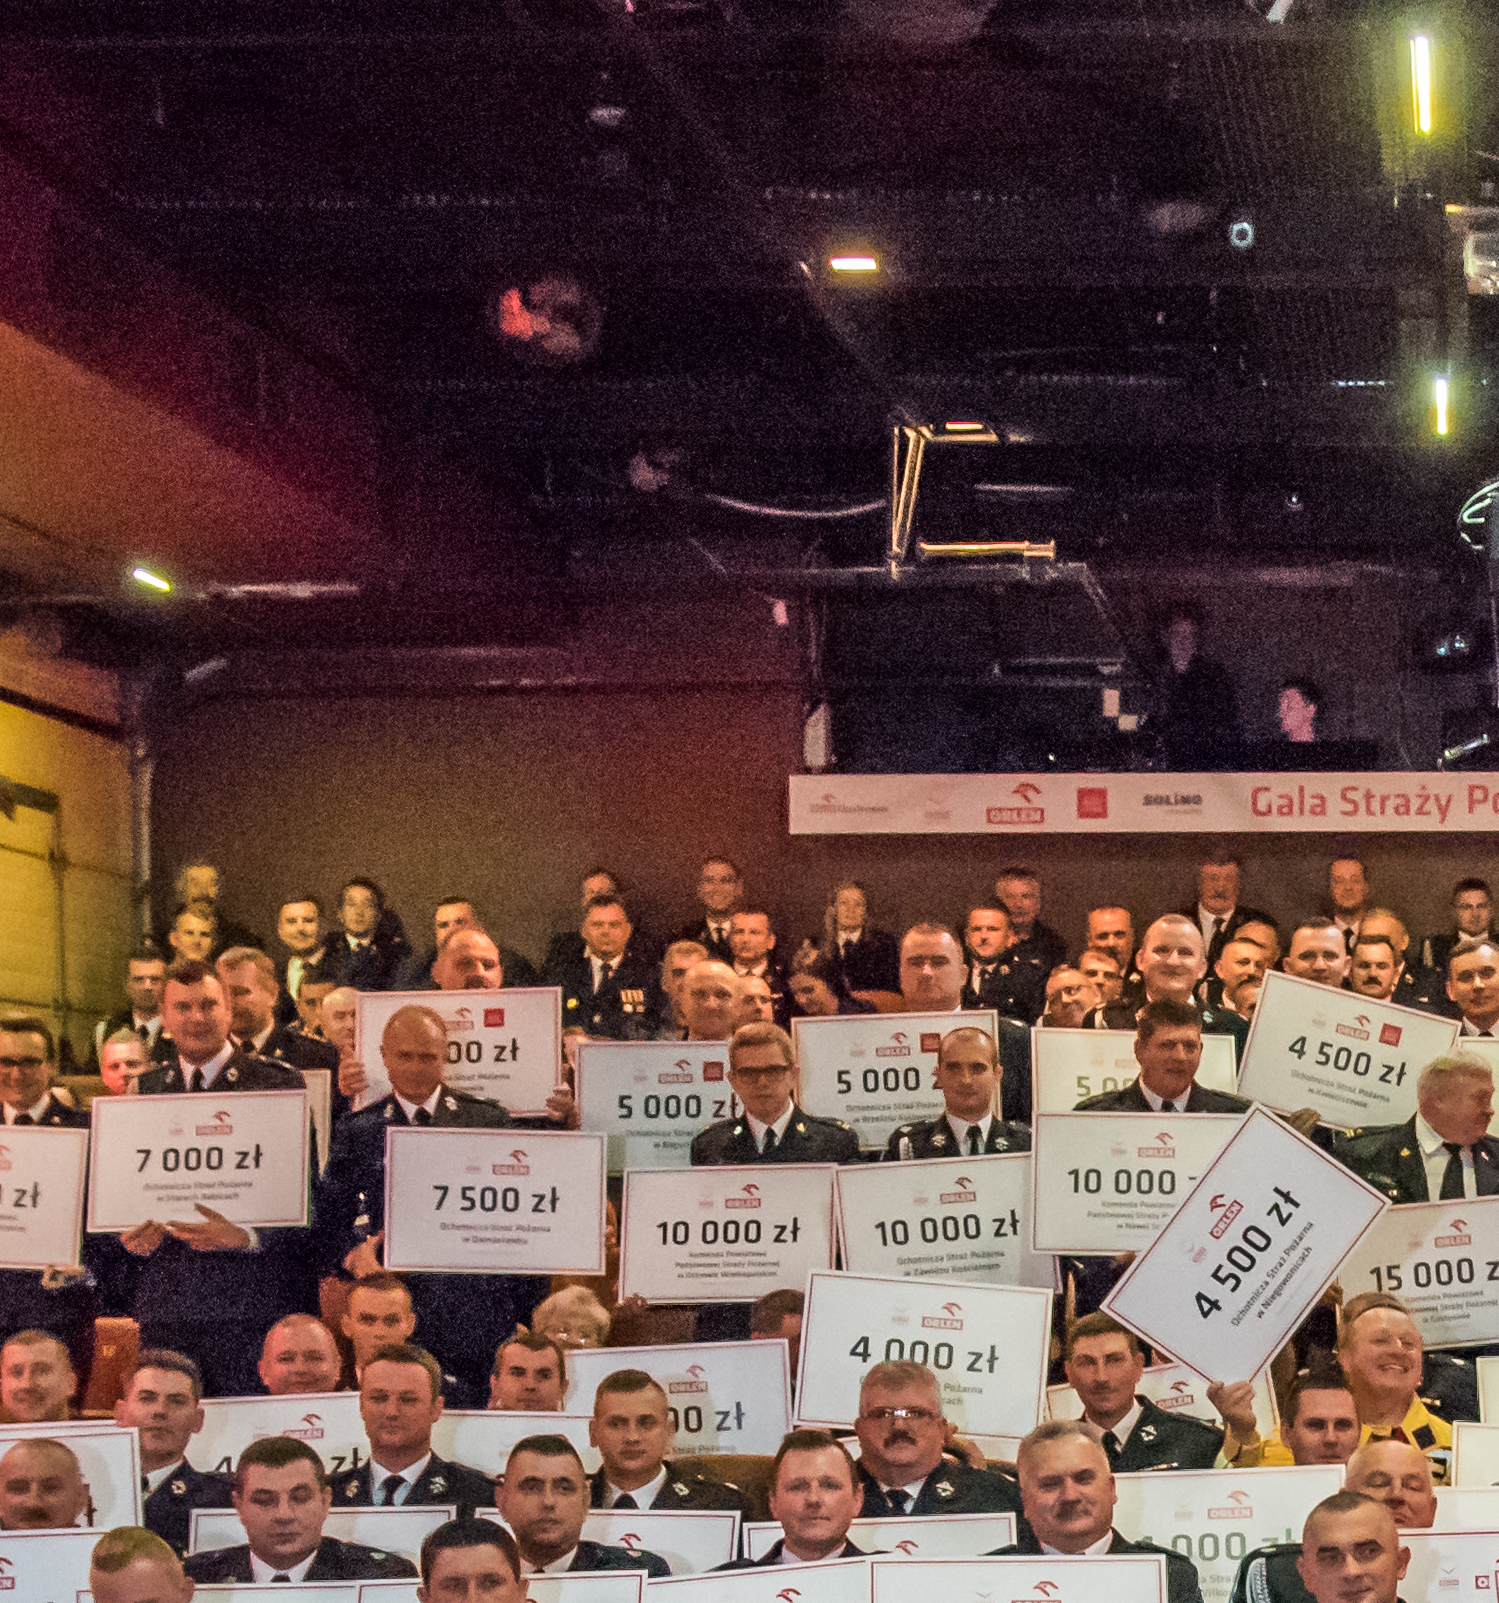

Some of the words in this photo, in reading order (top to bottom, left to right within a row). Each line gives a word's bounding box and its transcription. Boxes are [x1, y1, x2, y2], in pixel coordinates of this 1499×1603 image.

[1251, 785, 1326, 817] Gala
[1340, 785, 1452, 824] Straży
[1289, 1036, 1306, 1060] 4
[1316, 1042, 1371, 1076] 500
[1379, 1062, 1406, 1086] zł
[137, 1149, 152, 1172] 7
[163, 1147, 223, 1172] 000
[235, 1144, 263, 1169] zł
[13, 1182, 40, 1208] zł
[433, 1185, 449, 1210] 7
[460, 1186, 519, 1212] 500
[532, 1186, 560, 1213] zł
[657, 1221, 689, 1245] 10
[702, 1219, 761, 1244] 000
[774, 1217, 800, 1243] zł
[875, 1220, 909, 1246] 10
[921, 1214, 981, 1243] 000
[993, 1209, 1019, 1237] zł
[1195, 1292, 1222, 1318] 4
[1210, 1225, 1271, 1292] 500
[1267, 1187, 1300, 1227] zł
[850, 1336, 871, 1363] 4
[882, 1339, 954, 1369] 000
[967, 1345, 999, 1373] zł
